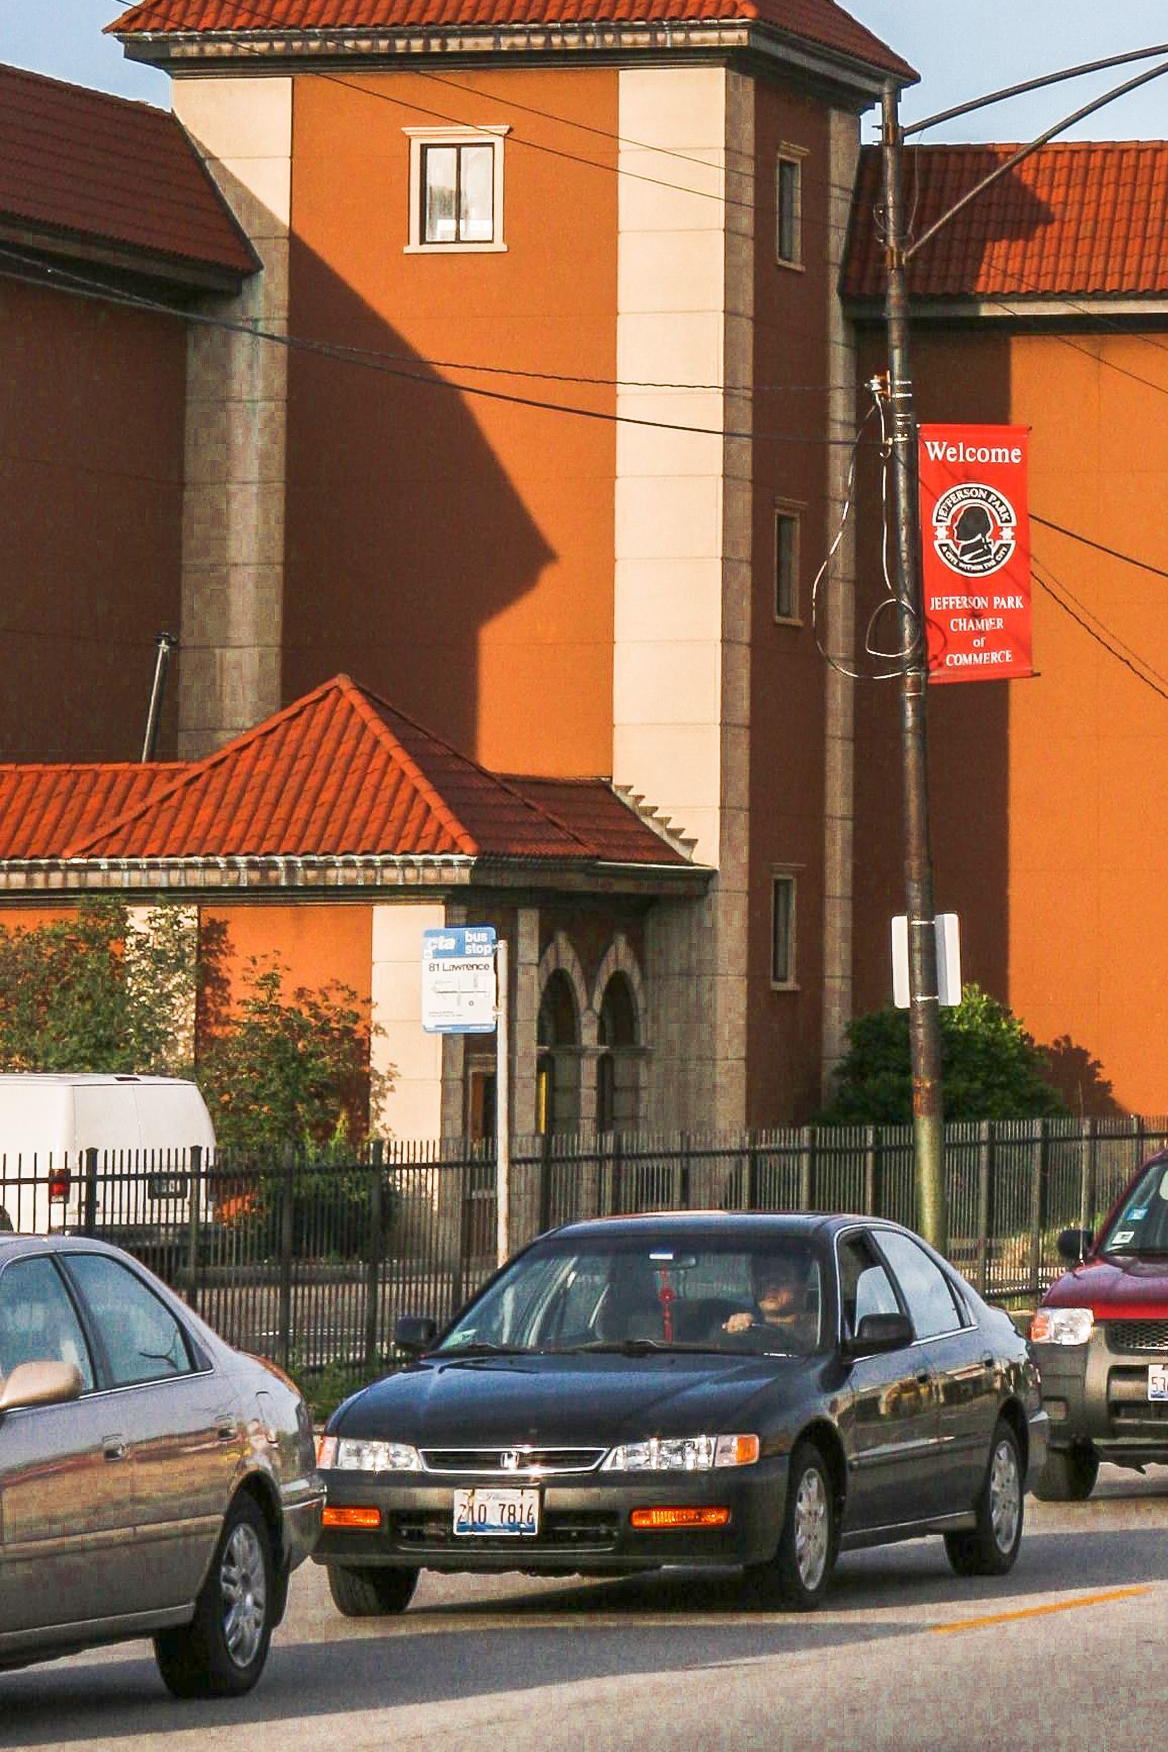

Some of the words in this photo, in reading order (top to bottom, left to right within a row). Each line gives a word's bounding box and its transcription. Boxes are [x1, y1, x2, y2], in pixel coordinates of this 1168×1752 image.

[925, 441, 1022, 464] Welcome
[937, 488, 988, 523] JEFFERSON
[987, 494, 1010, 521] PARK
[930, 595, 989, 611] JEFFERSON
[993, 595, 1024, 609] PARK
[972, 637, 987, 648] of
[946, 650, 1013, 666] COMMERCE
[464, 930, 488, 943] bus
[464, 943, 493, 955] stop
[428, 962, 440, 972] 81
[442, 962, 490, 972] Lawrence
[498, 1503, 535, 1525] 7816
